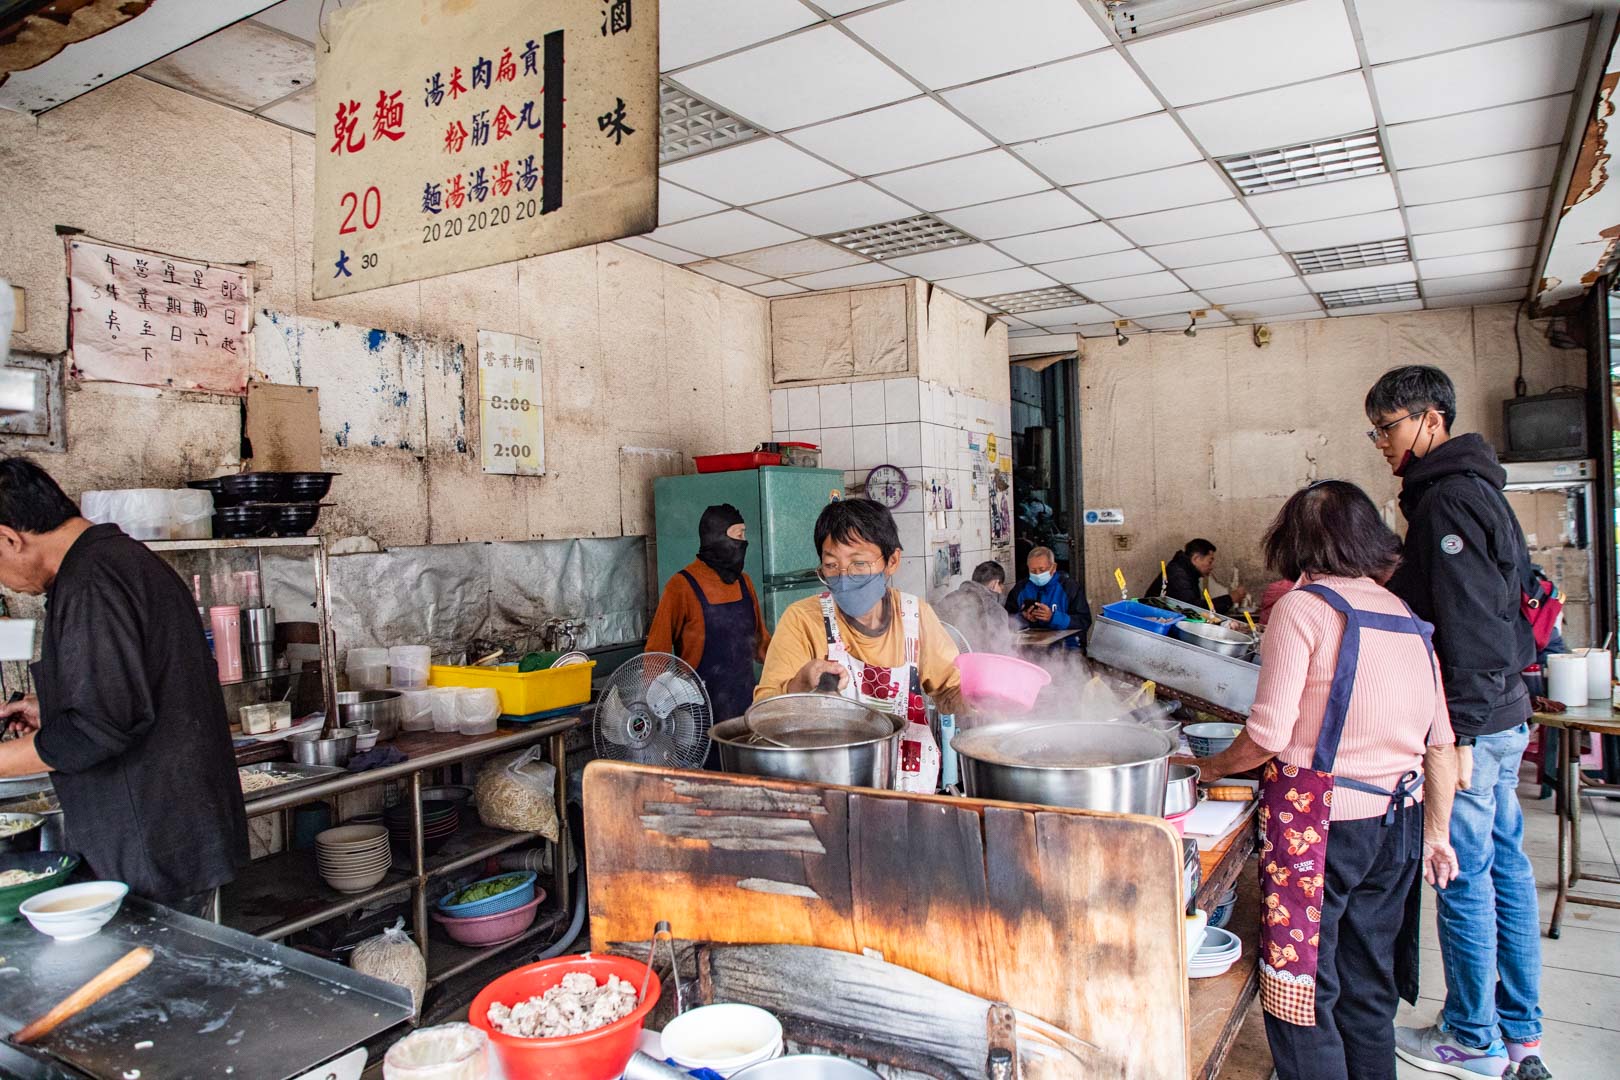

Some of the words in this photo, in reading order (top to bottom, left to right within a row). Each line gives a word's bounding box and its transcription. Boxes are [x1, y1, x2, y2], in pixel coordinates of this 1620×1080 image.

[330, 89, 406, 156] 乾麵
[443, 66, 468, 209] 米粉湯
[491, 47, 517, 196] 扁食湯
[515, 40, 541, 192] 貢丸湯
[339, 186, 381, 235] 20
[422, 224, 441, 243] 20
[445, 218, 463, 237] 20
[468, 211, 487, 232] 20
[491, 205, 510, 226] 20
[516, 199, 536, 220] 20
[333, 250, 352, 278] 大
[361, 253, 378, 269] 30
[162, 262, 182, 341] 星期日
[190, 269, 208, 346] 星期六
[221, 280, 237, 354] 即日起
[484, 351, 535, 373] 營業時間
[491, 395, 530, 412] 8:00
[493, 443, 531, 458] 2:00
